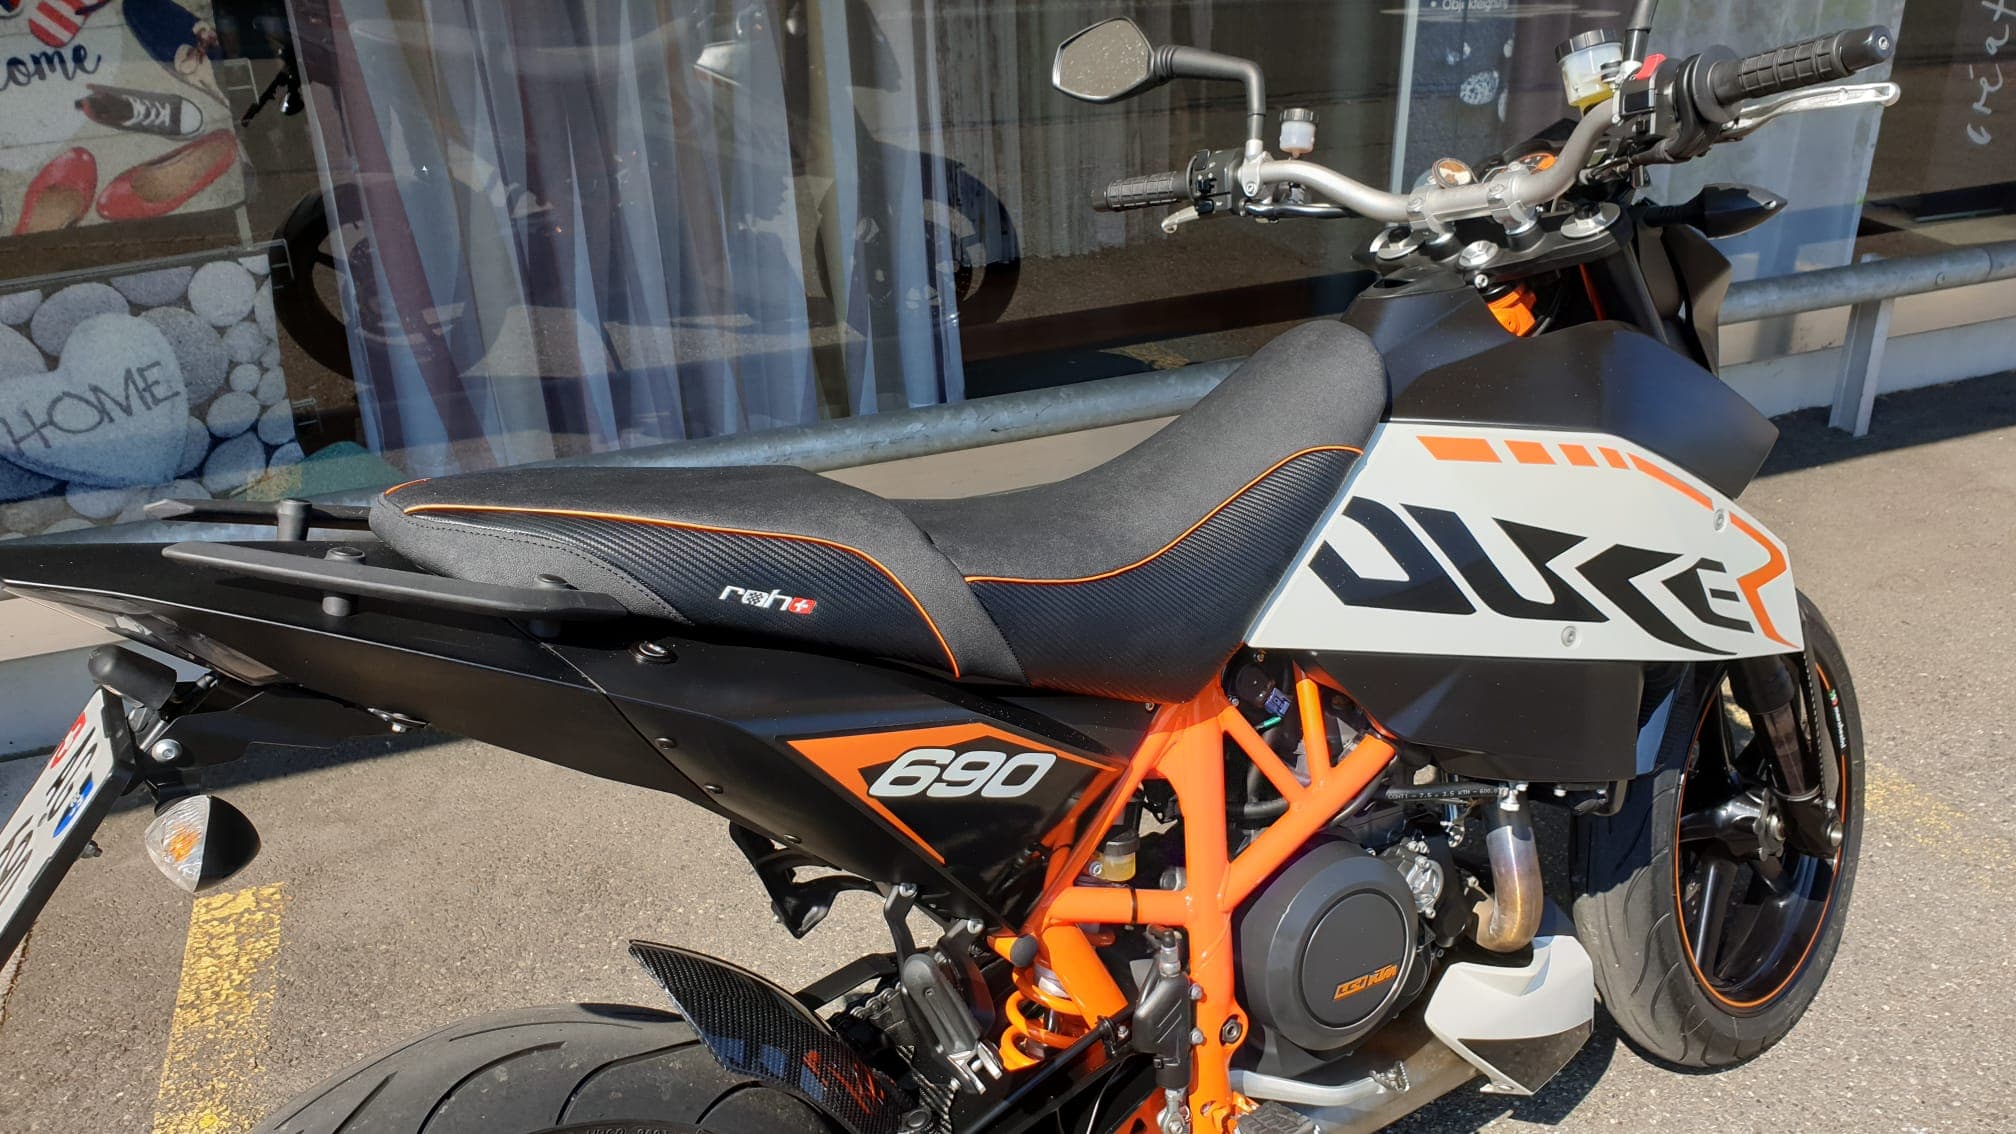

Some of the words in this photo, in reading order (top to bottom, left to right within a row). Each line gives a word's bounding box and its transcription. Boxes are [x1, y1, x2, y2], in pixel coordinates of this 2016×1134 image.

[0, 44, 102, 92] ome
[0, 360, 181, 457] HOME
[1308, 496, 1754, 655] DUKE
[867, 748, 1057, 799] 690
